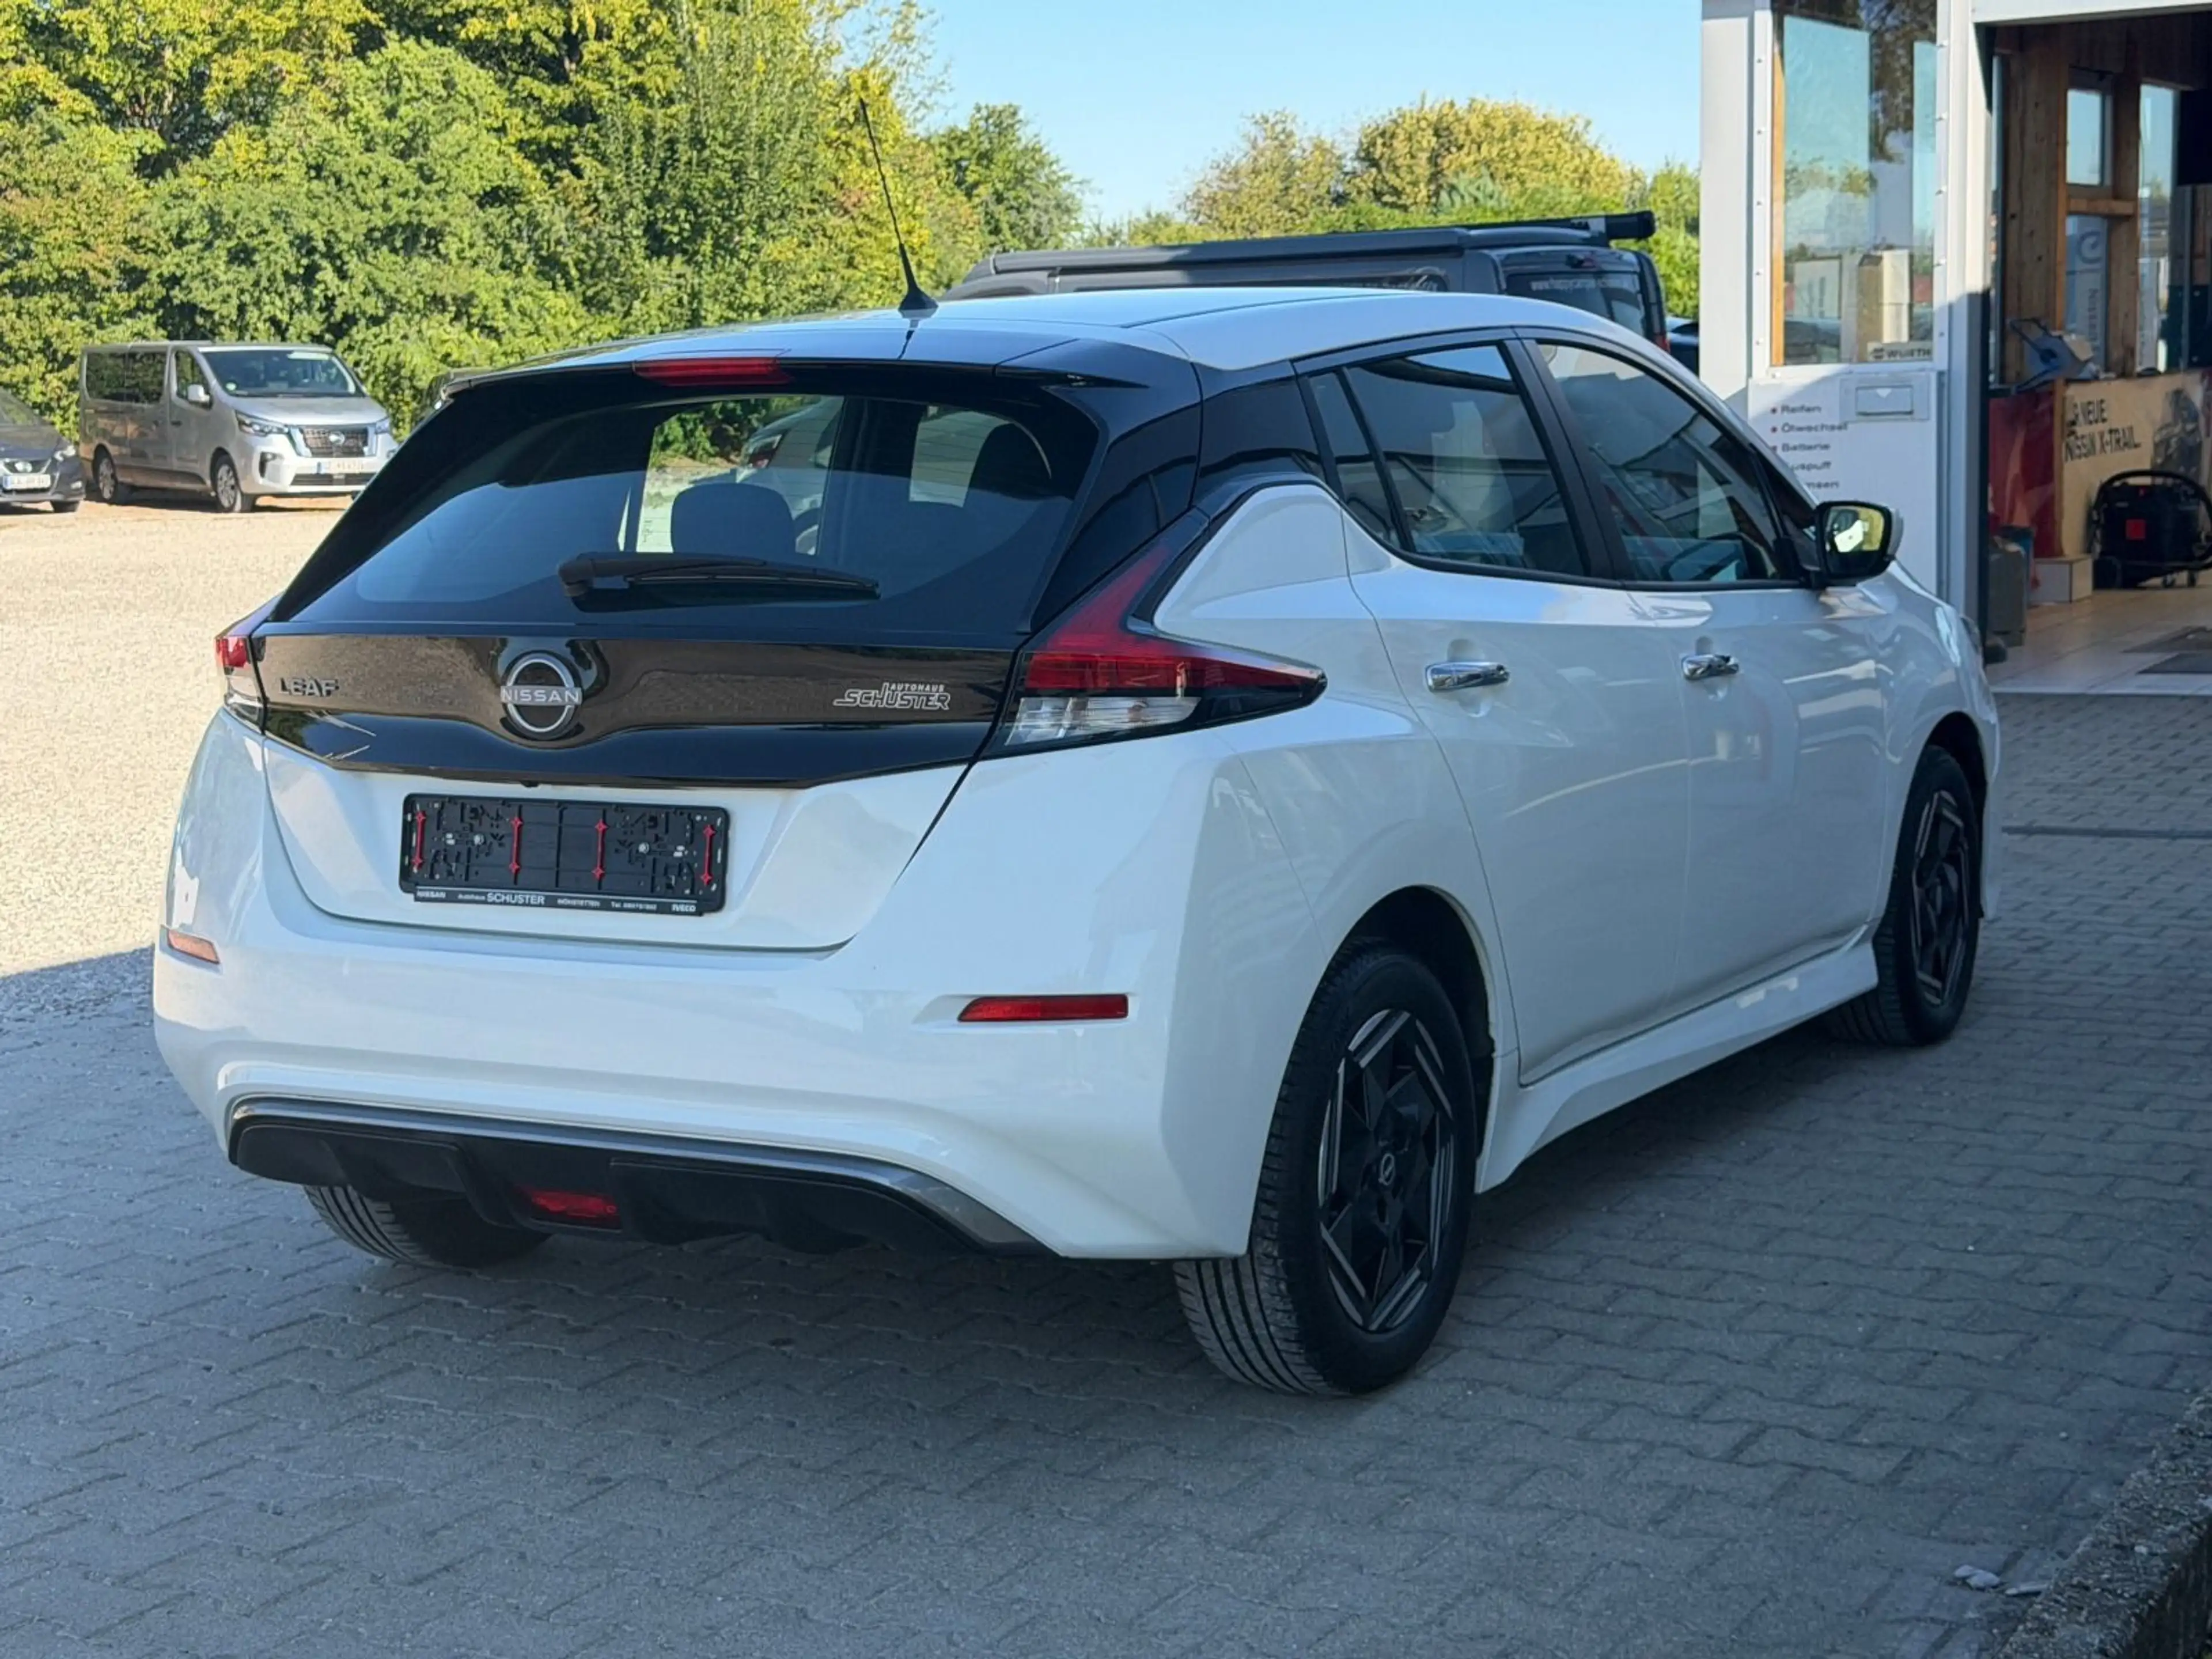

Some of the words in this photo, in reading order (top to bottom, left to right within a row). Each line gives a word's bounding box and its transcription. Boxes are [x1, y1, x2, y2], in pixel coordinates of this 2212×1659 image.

[278, 677, 336, 698] LEAF
[889, 683, 945, 692] AUTOHAUS
[502, 688, 579, 703] NISSAN
[833, 682, 950, 710] SCHUSTER
[486, 892, 546, 906] SCHUSTER
